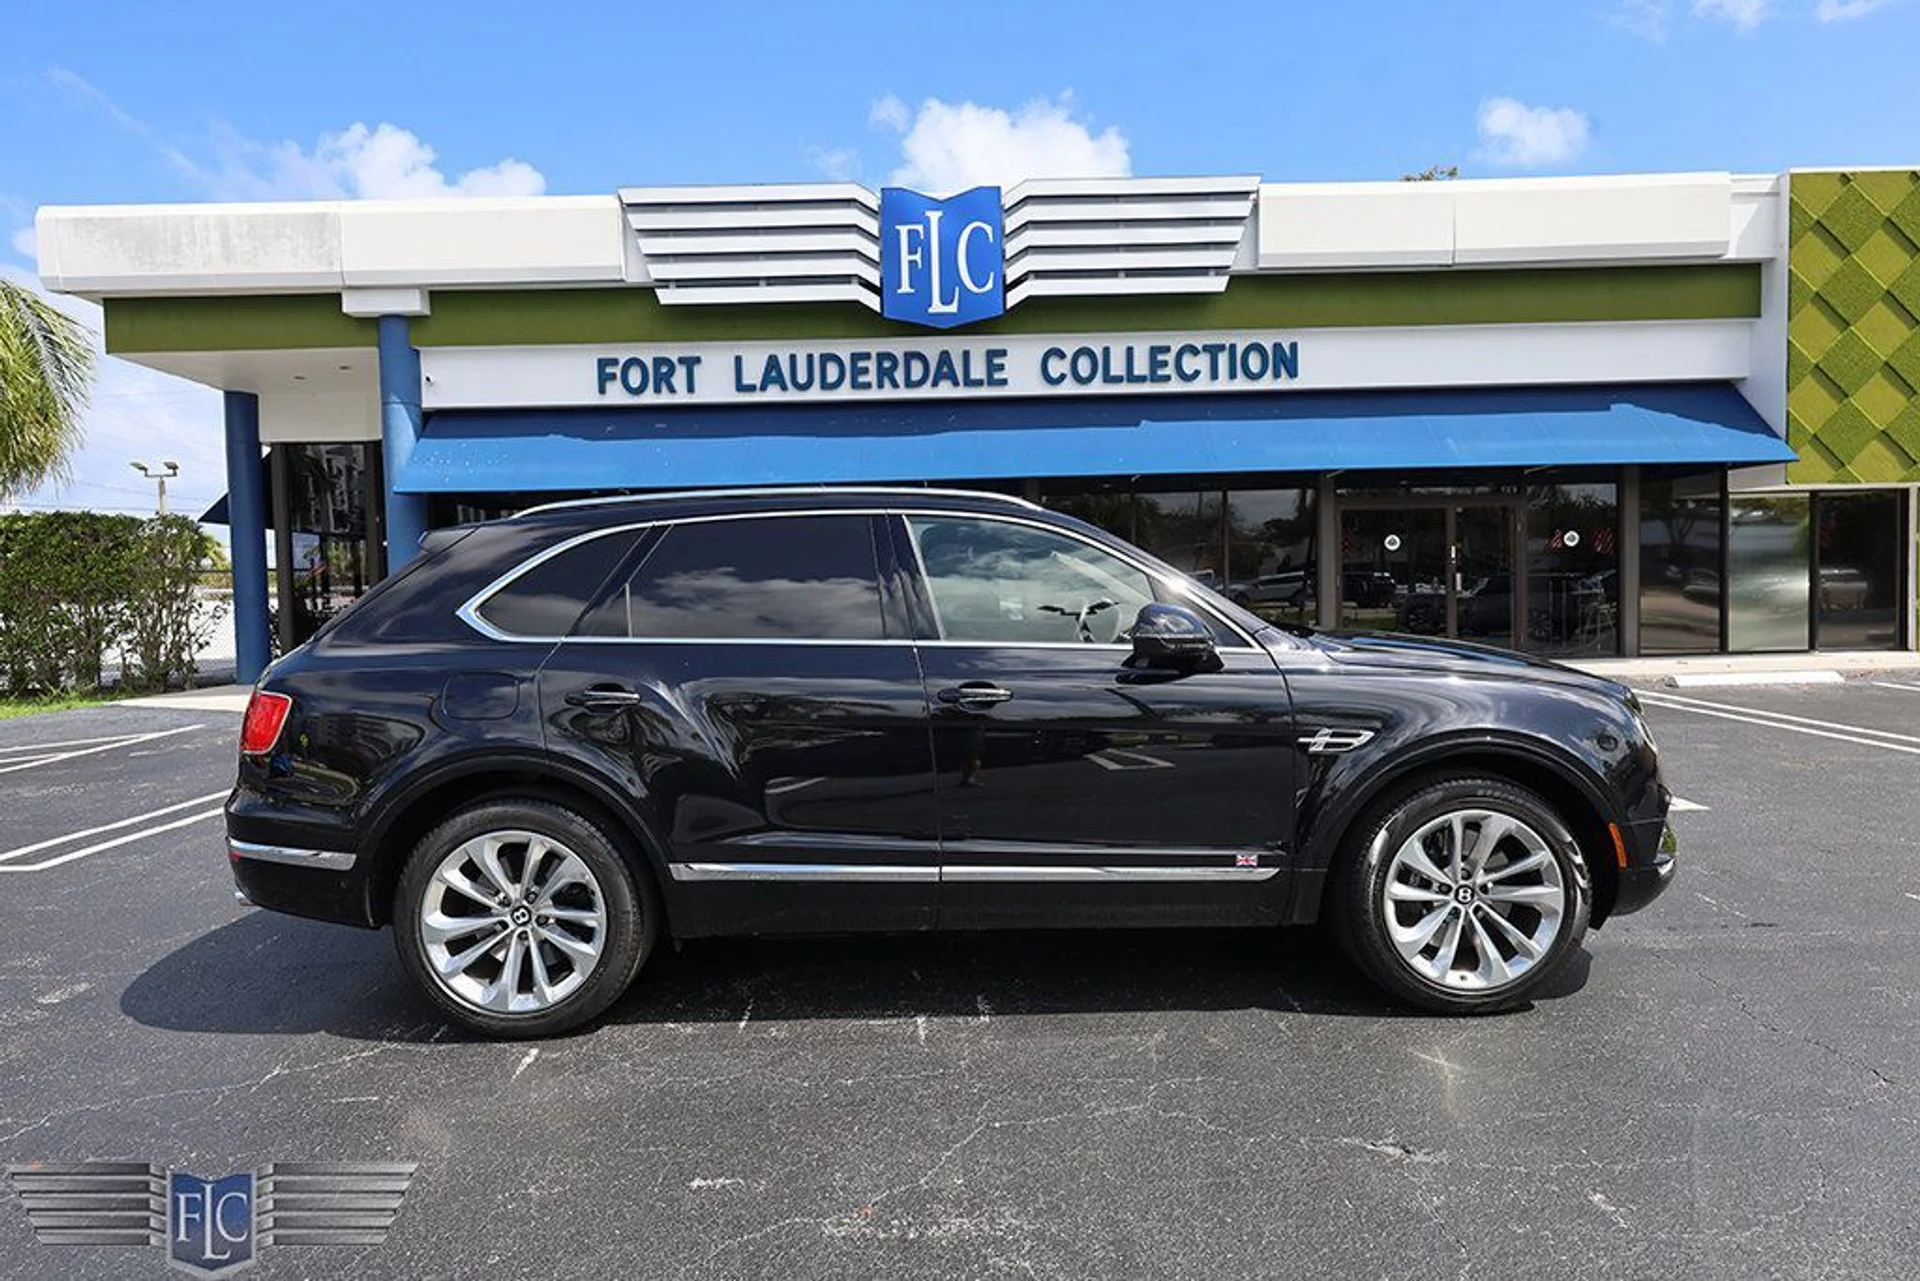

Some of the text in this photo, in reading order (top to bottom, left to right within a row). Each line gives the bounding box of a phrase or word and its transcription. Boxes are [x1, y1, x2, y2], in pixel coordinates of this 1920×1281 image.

[896, 210, 995, 313] FLC
[598, 342, 1299, 395] FORT LAUDERDALE COLLECTION
